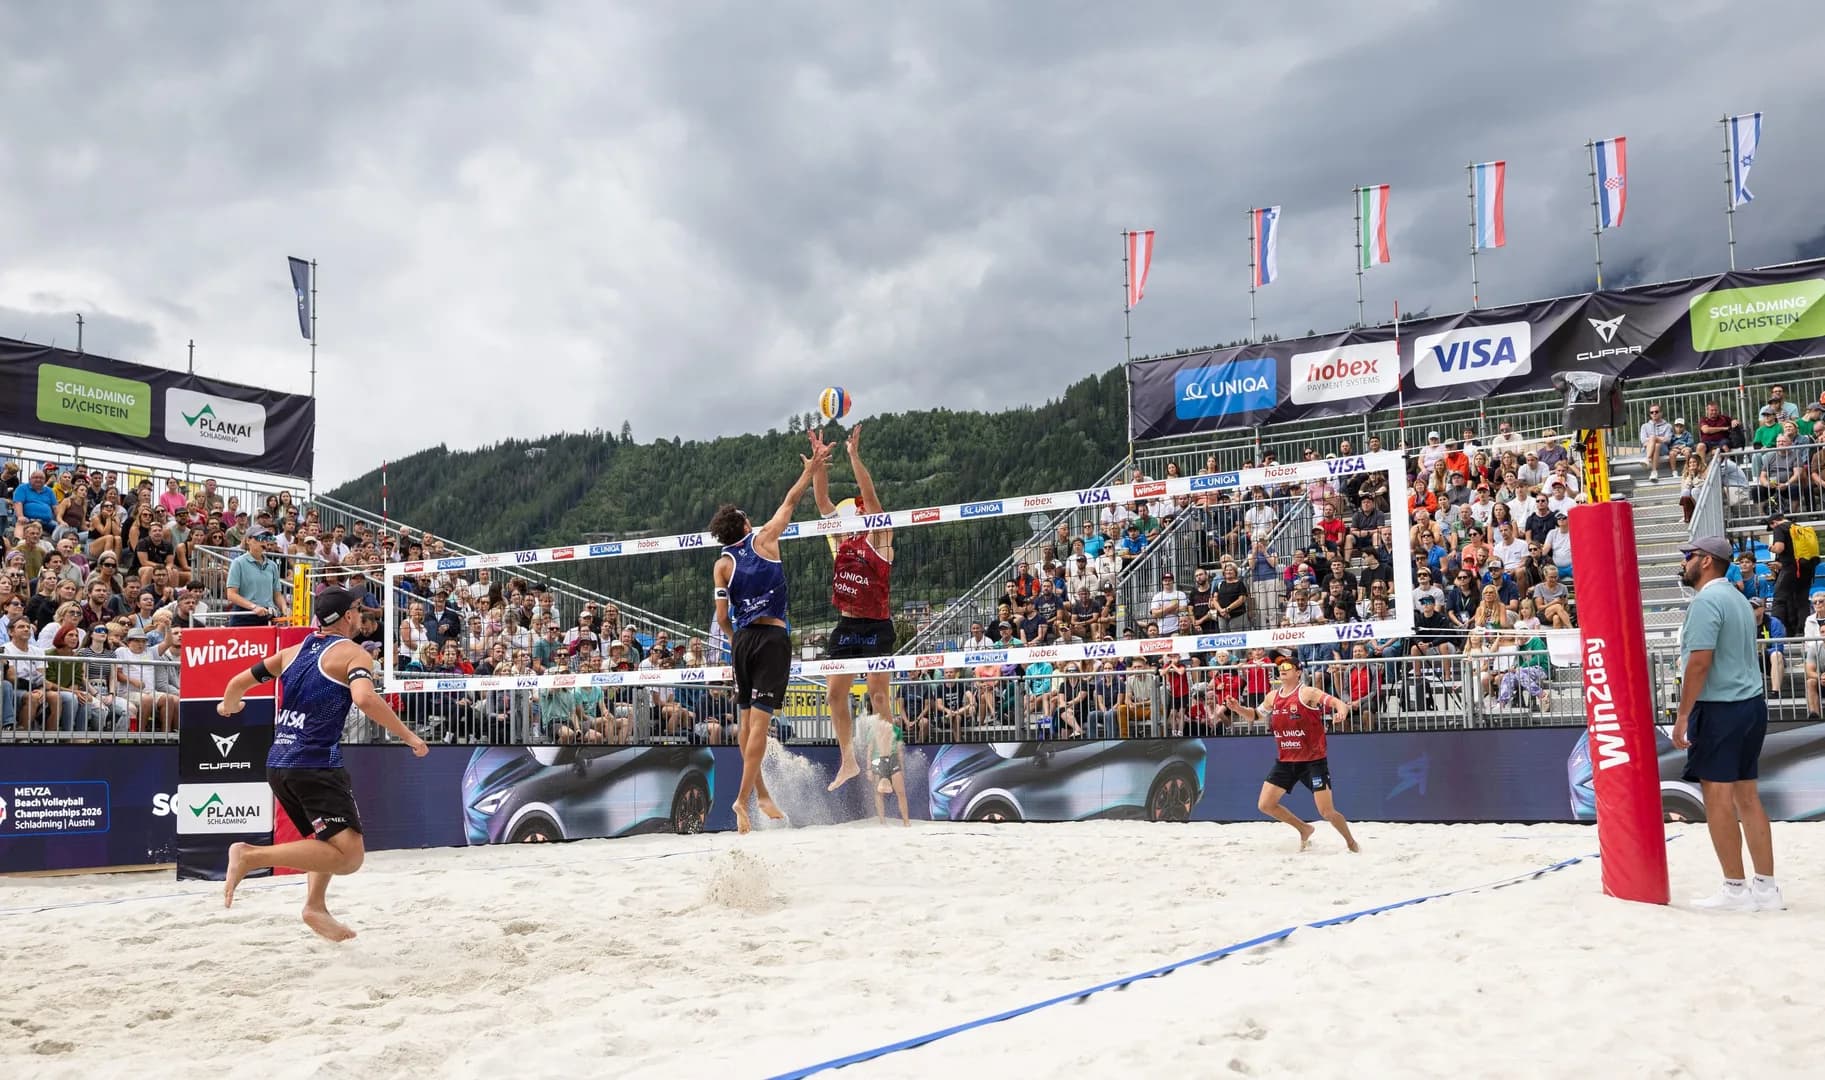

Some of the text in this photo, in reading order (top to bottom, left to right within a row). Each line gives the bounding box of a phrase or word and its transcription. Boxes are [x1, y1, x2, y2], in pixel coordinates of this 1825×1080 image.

[1709, 296, 1808, 319] SCHLADMING
[1719, 312, 1800, 333] DACHSTEIN
[1433, 336, 1517, 373] VISA
[1577, 345, 1642, 361] CUPRA
[1308, 359, 1379, 383] hobex
[1211, 376, 1269, 398] UNIQA
[1307, 375, 1380, 392] PAYMENT SYSTEMS
[55, 381, 136, 406] SCHLADMING
[62, 397, 129, 420] DACHSTEIN
[200, 417, 251, 438] PLANAI
[199, 430, 239, 444] SCHLADMING
[1264, 466, 1297, 479] hobex
[1327, 457, 1366, 475] VISA
[1207, 475, 1237, 487] UNIQA
[1024, 496, 1052, 508] hobex
[1078, 489, 1111, 505] VISA
[975, 504, 1001, 513] UNIQA
[817, 520, 842, 531] hobex
[864, 514, 893, 529] VISA
[677, 535, 703, 548] VISA
[515, 552, 537, 563] VISA
[840, 571, 870, 586] UNIQA
[1272, 630, 1305, 642] hobex
[1336, 624, 1375, 641] VISA
[1215, 637, 1243, 647] UNIQA
[185, 638, 268, 668] win2day
[1029, 648, 1058, 659] hobex
[1084, 643, 1117, 658] VISA
[867, 658, 896, 671] VISA
[681, 670, 705, 680] VISA
[517, 678, 539, 687] VISA
[1586, 638, 1631, 770] win2day
[277, 709, 306, 730] VISA
[199, 761, 251, 770] CUPRA
[14, 787, 51, 796] MEVZA
[15, 797, 84, 808] Beach Volleyball
[15, 807, 102, 819] Championships 2026
[207, 805, 260, 818] PLANAI
[15, 819, 62, 830] Schladming
[68, 818, 95, 828] Austria
[207, 817, 247, 825] SCHLADMING
